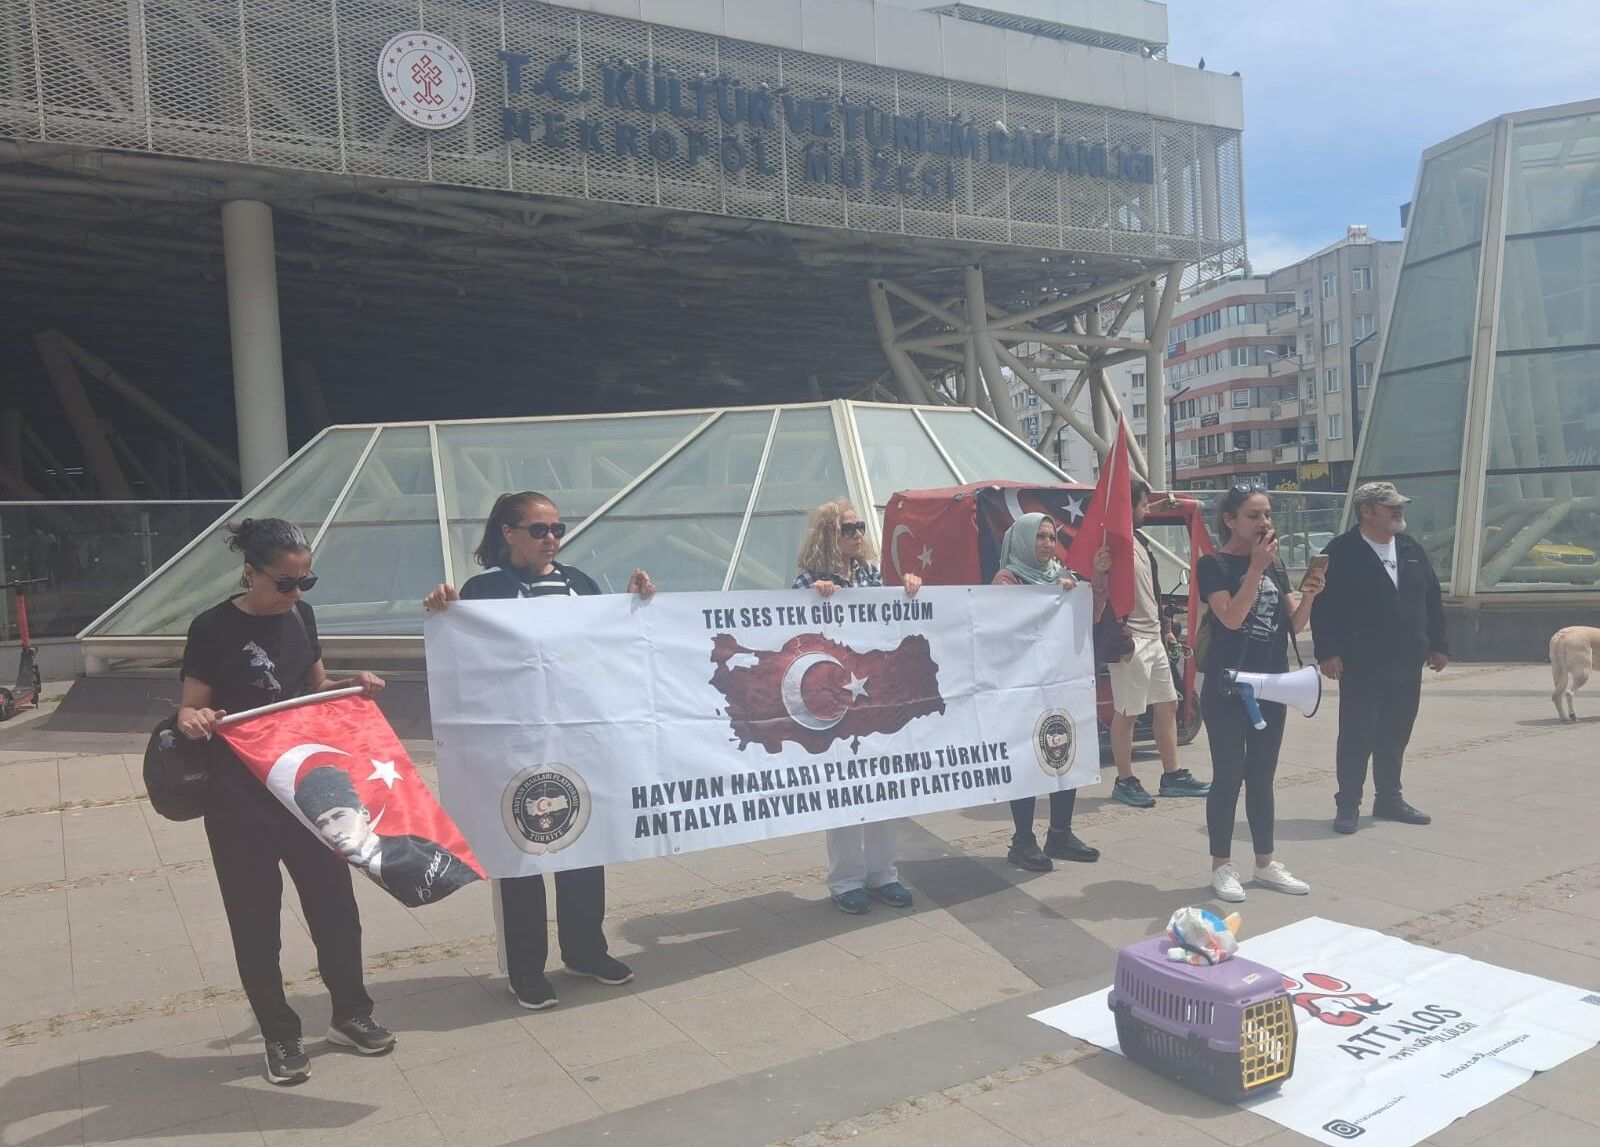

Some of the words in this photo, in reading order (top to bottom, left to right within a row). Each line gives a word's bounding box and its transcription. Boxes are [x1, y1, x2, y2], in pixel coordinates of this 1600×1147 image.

[600, 61, 773, 129] KÜLTÜR
[779, 94, 834, 137] VE
[702, 608, 736, 629] TEK
[739, 606, 773, 628] SES
[776, 605, 808, 626] TEK
[811, 602, 845, 628] GÜÇ
[848, 603, 878, 623] TEK
[881, 599, 934, 626] ÇÖZÜM
[631, 775, 724, 809] HAYVAN
[731, 764, 820, 796] HAKLARI
[823, 751, 932, 783] PLATFORMU
[935, 740, 1010, 768] TÜRKİYE
[634, 802, 738, 839] ANTALYA
[742, 790, 822, 822] HAYVAN
[826, 779, 906, 810] HAKLARI
[910, 765, 1012, 797] PLATFORMU
